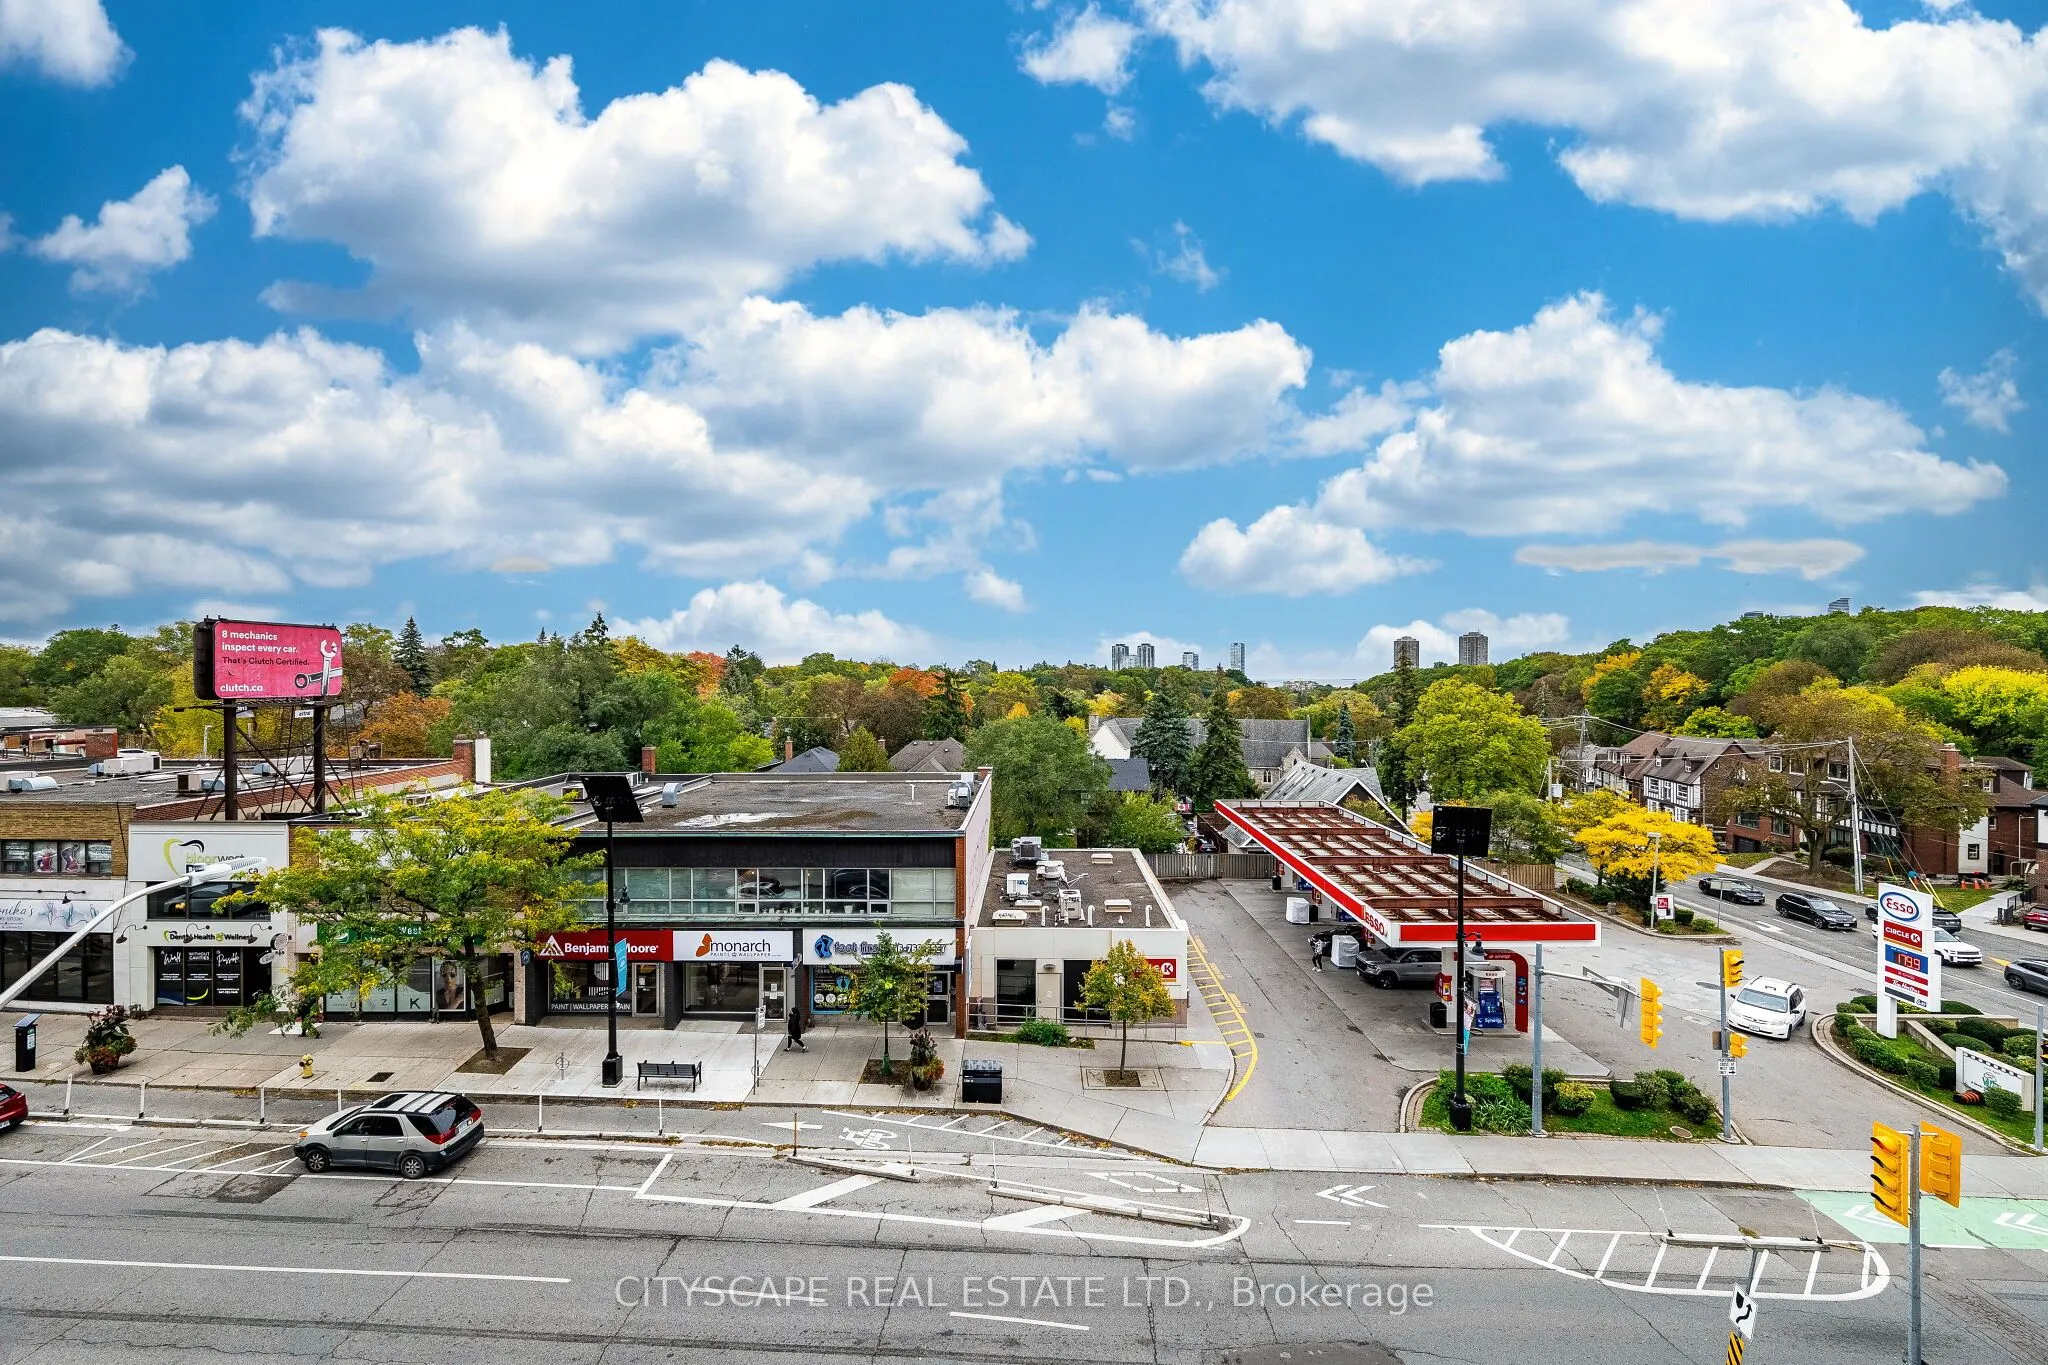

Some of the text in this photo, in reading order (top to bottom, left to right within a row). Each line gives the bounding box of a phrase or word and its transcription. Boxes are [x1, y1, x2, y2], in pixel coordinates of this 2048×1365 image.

[221, 630, 278, 640] 8 mechanics
[221, 642, 298, 654] inspect every car.
[221, 656, 310, 666] That's Clutch Certified.
[220, 683, 263, 692] clutch.ca
[0, 900, 34, 917] nika's
[398, 926, 422, 935] West
[1885, 926, 1910, 939] CIRCLE
[711, 939, 771, 952] monarch
